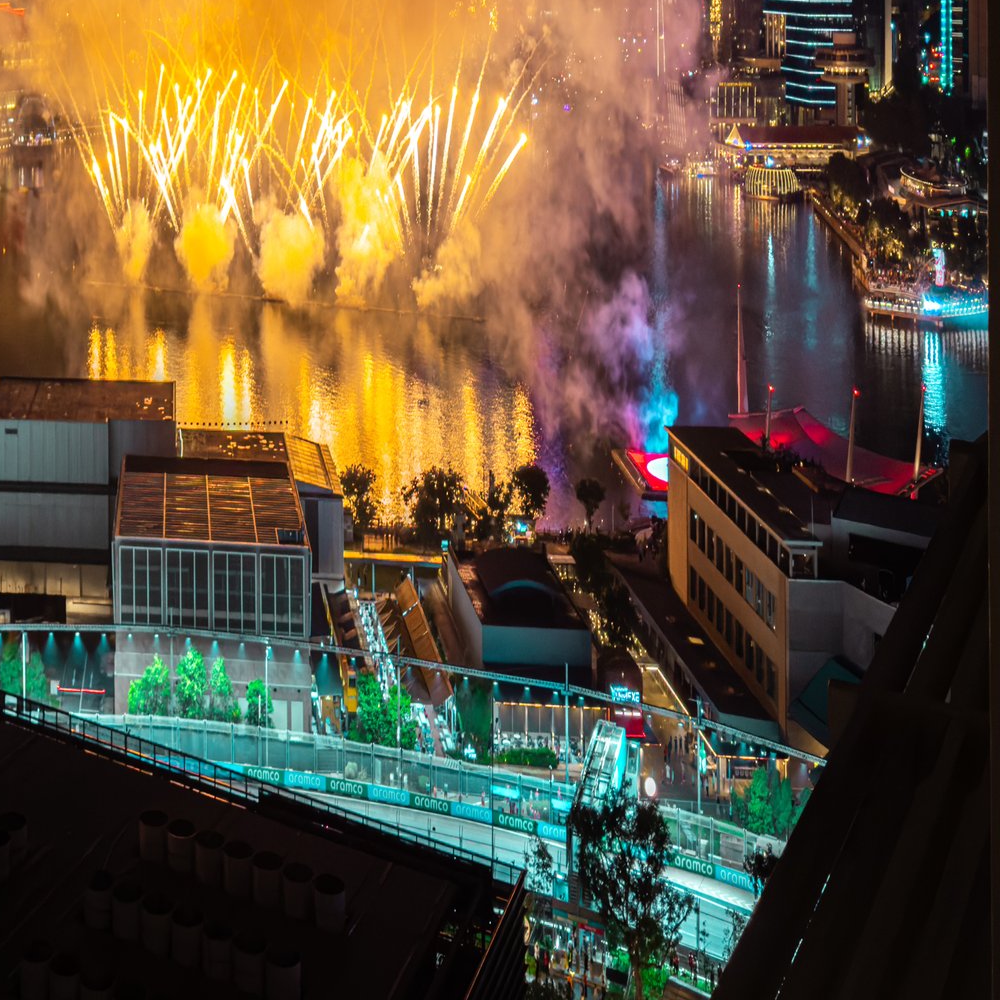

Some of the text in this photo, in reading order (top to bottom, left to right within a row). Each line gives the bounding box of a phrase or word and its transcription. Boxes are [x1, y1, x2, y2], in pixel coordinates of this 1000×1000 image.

[247, 768, 280, 782] aramco
[288, 773, 321, 787] aramco
[330, 779, 364, 795] aramco
[372, 784, 406, 802] aramco
[414, 795, 449, 812] aramco
[455, 804, 490, 820] aramco
[498, 813, 534, 832] aramco
[674, 855, 713, 876] aramco
